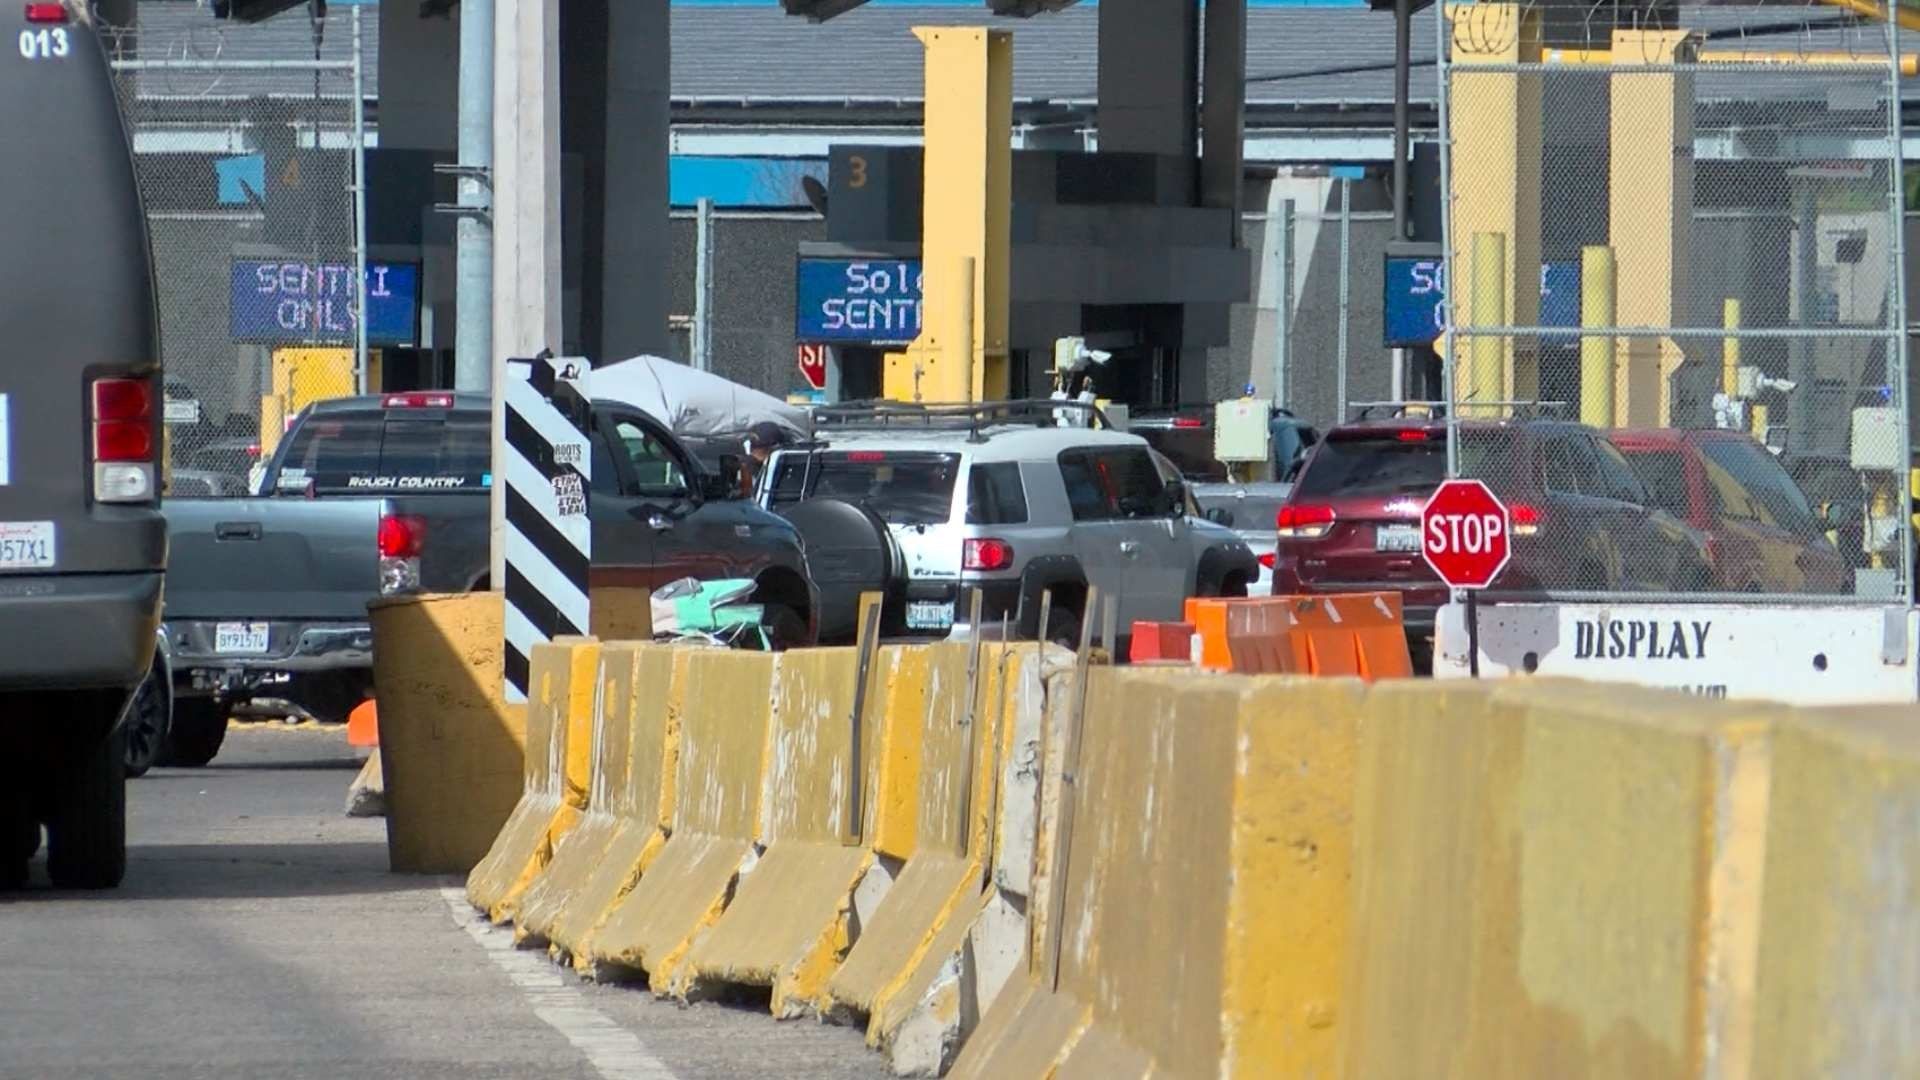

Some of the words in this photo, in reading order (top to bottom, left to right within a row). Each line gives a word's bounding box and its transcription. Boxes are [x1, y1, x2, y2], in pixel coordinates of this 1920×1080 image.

[19, 28, 69, 58] 013
[849, 156, 867, 187] 3
[846, 263, 923, 293] Sol
[822, 299, 922, 329] SENT
[555, 444, 582, 455] ROOTS
[349, 476, 394, 487] ROUGH
[399, 476, 465, 487] COUNTRY
[1427, 513, 1502, 554] STOP
[0, 539, 48, 562] 57X1
[1575, 620, 1711, 659] DISPLAY
